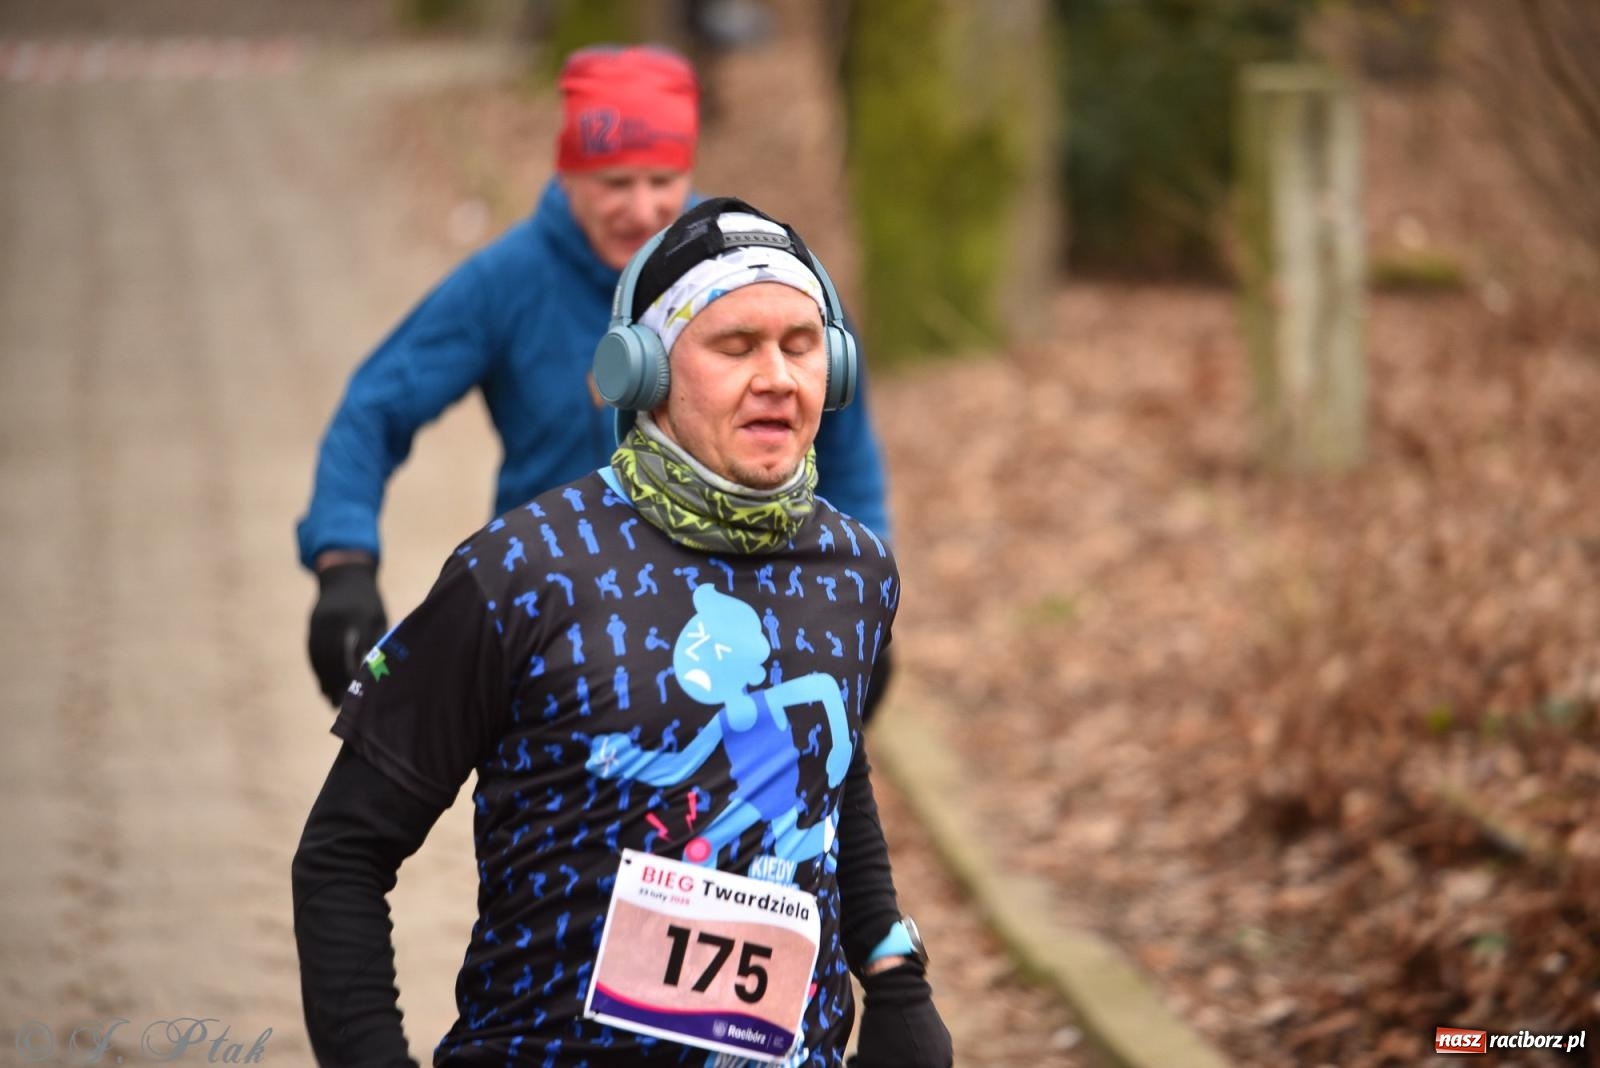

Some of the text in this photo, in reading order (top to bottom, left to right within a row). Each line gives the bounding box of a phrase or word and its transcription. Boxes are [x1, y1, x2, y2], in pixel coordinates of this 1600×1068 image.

[642, 865, 810, 921] BIEG Twardziela
[751, 855, 796, 883] KIEDY
[663, 924, 773, 1005] 175
